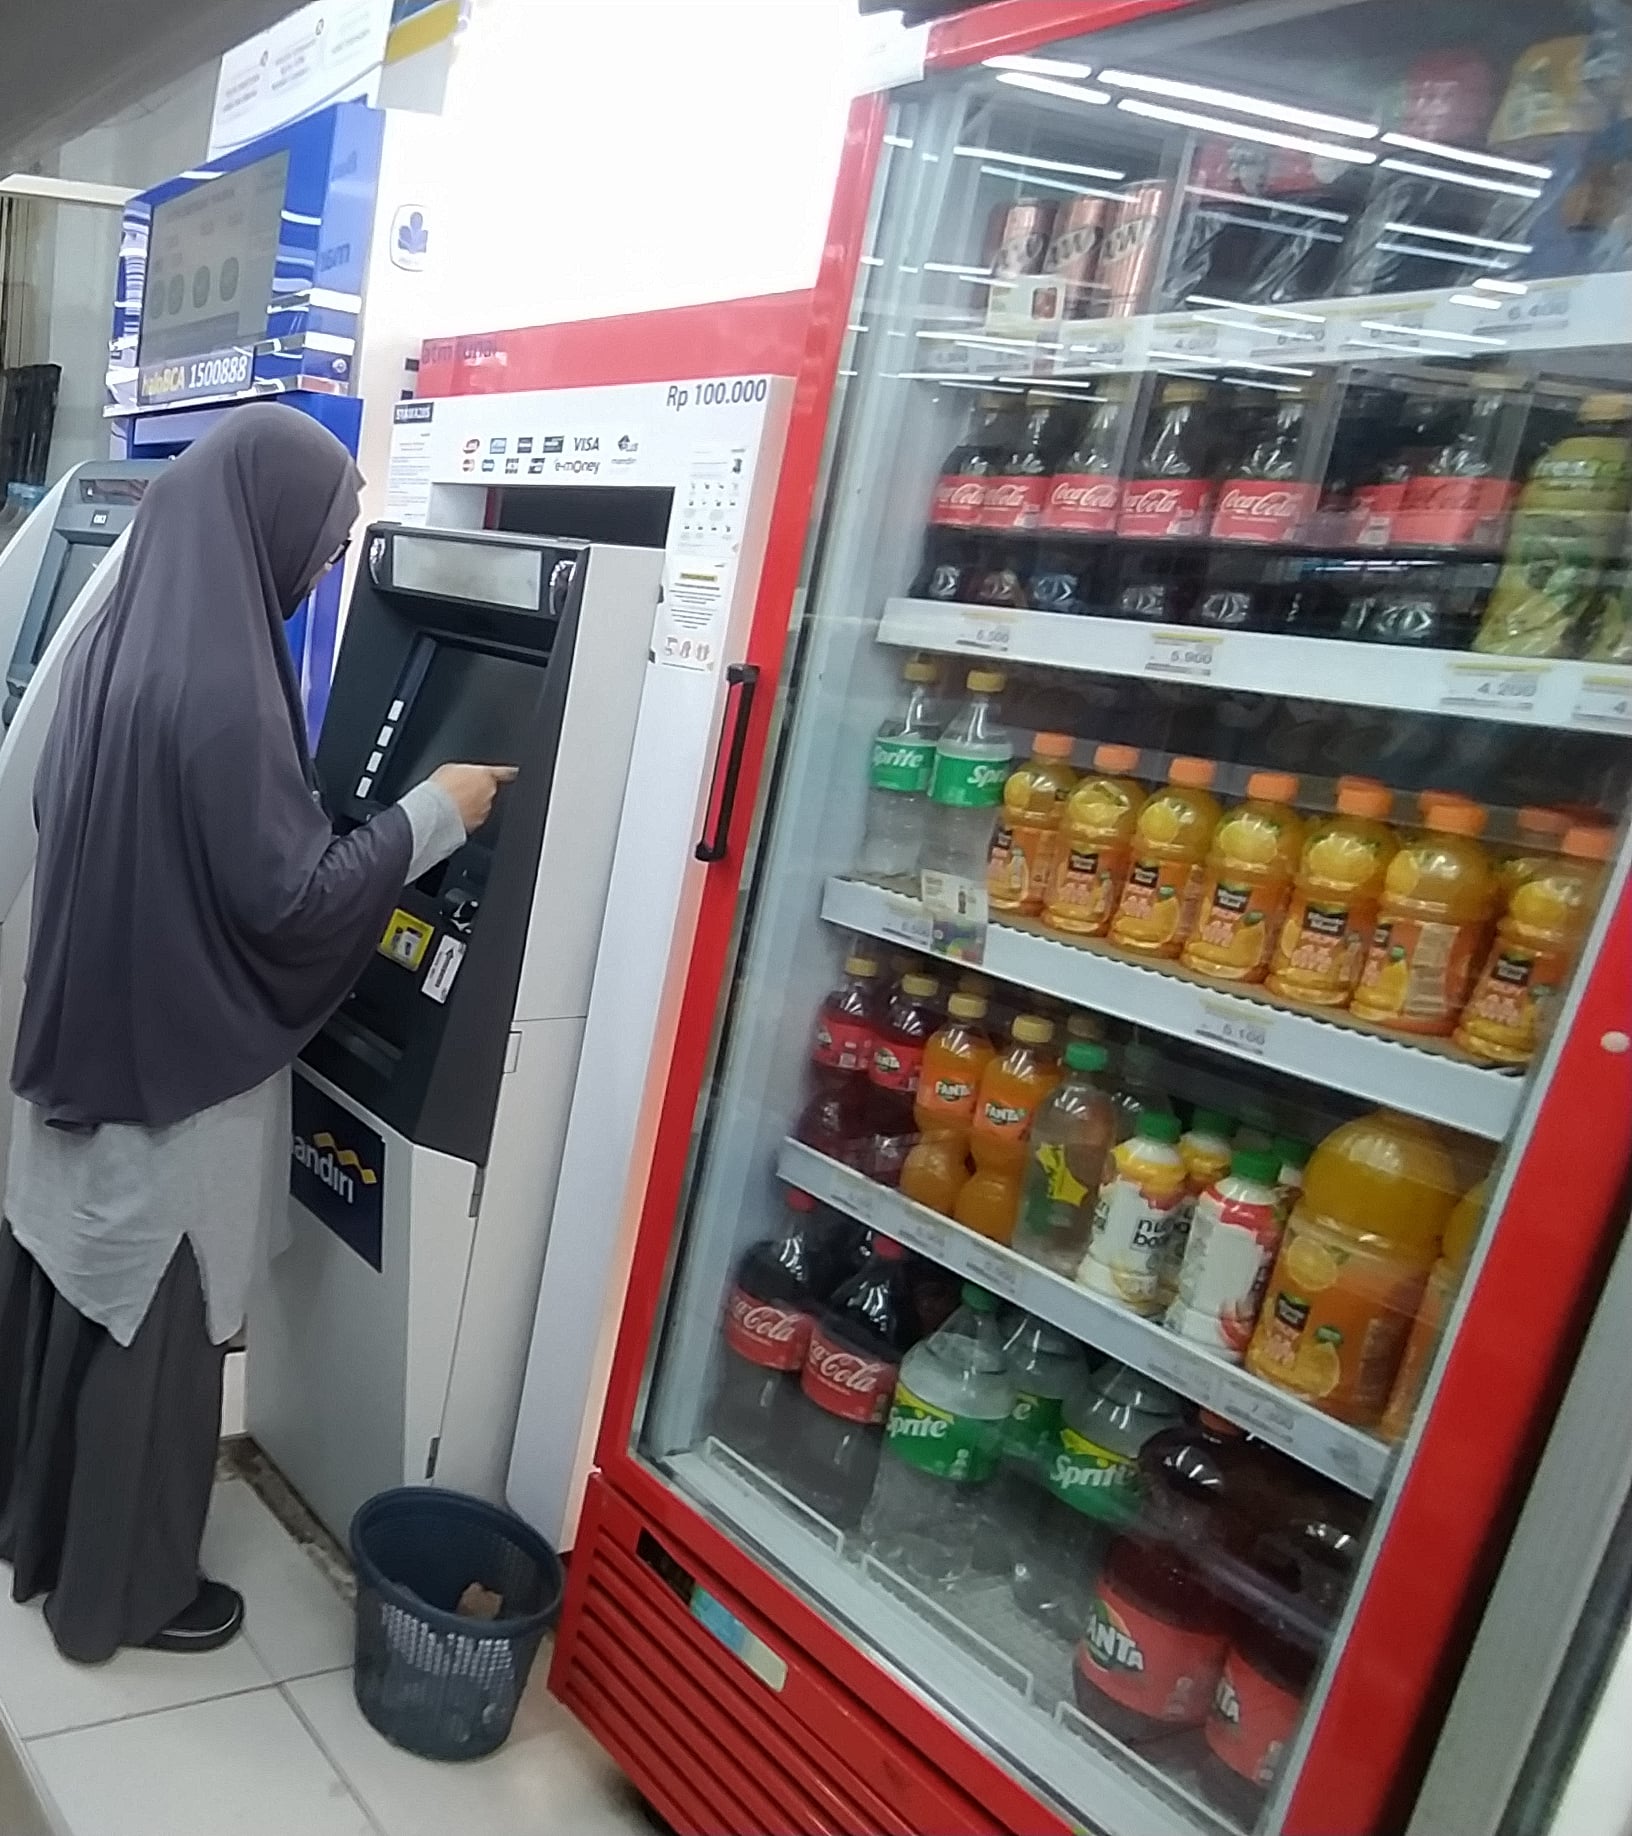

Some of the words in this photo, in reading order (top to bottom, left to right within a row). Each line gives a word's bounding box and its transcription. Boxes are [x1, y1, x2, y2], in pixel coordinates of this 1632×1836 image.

[188, 355, 249, 390] 1500888
[666, 385, 688, 411] Rp
[695, 379, 768, 406] 100.000
[573, 437, 601, 452] VISA
[292, 1135, 354, 1204] andiri
[1086, 1612, 1145, 1672] ANTA
